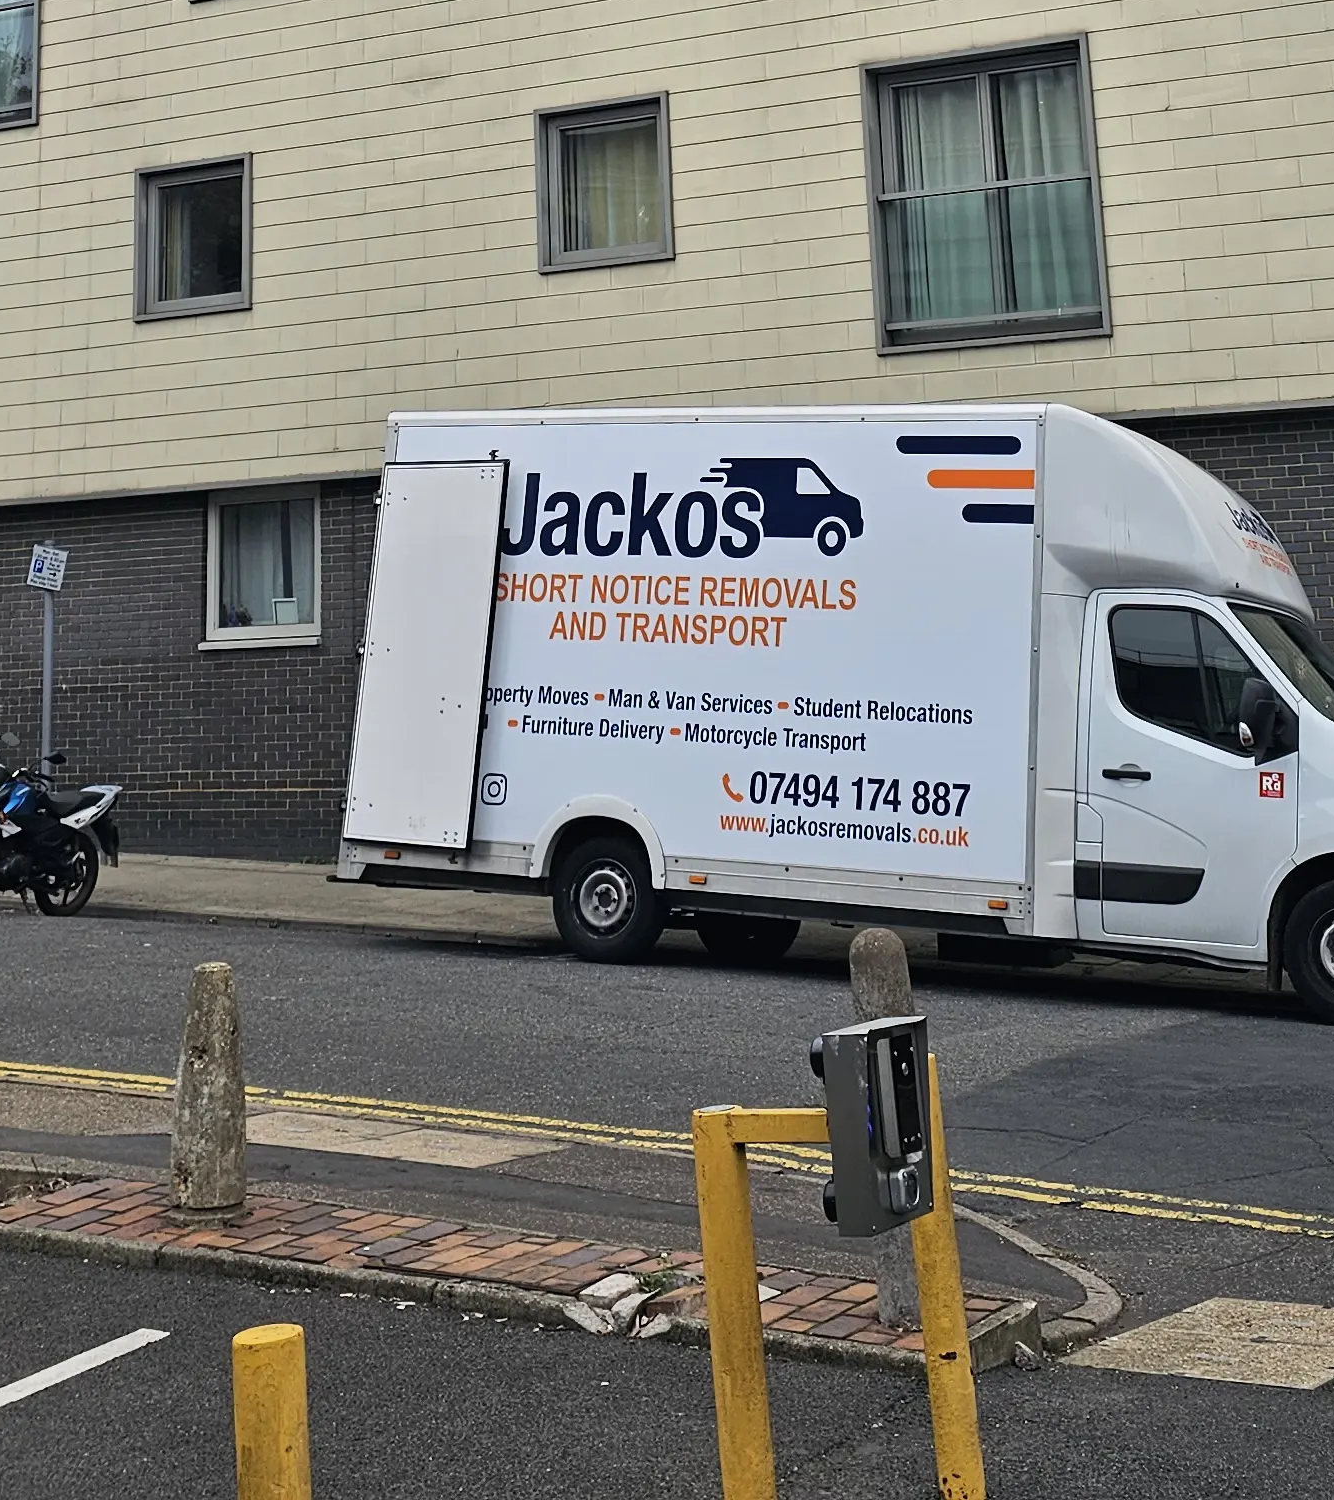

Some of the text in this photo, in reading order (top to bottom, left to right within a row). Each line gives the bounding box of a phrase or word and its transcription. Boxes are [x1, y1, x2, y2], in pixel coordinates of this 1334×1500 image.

[501, 472, 761, 558] Jackos
[497, 572, 857, 610] SHORT NOTICE REMOVALS
[549, 611, 787, 647] AND TRANSPORT
[487, 686, 589, 707] operty Moves
[608, 689, 773, 714] Man & Van Services
[793, 697, 973, 725] Student Relocations
[522, 715, 665, 744] Furniture Delivery
[685, 723, 867, 754] Motorcycle Transport
[750, 771, 971, 817] 07494 174 887
[720, 814, 969, 848] www.jackosremovals.co.uk
